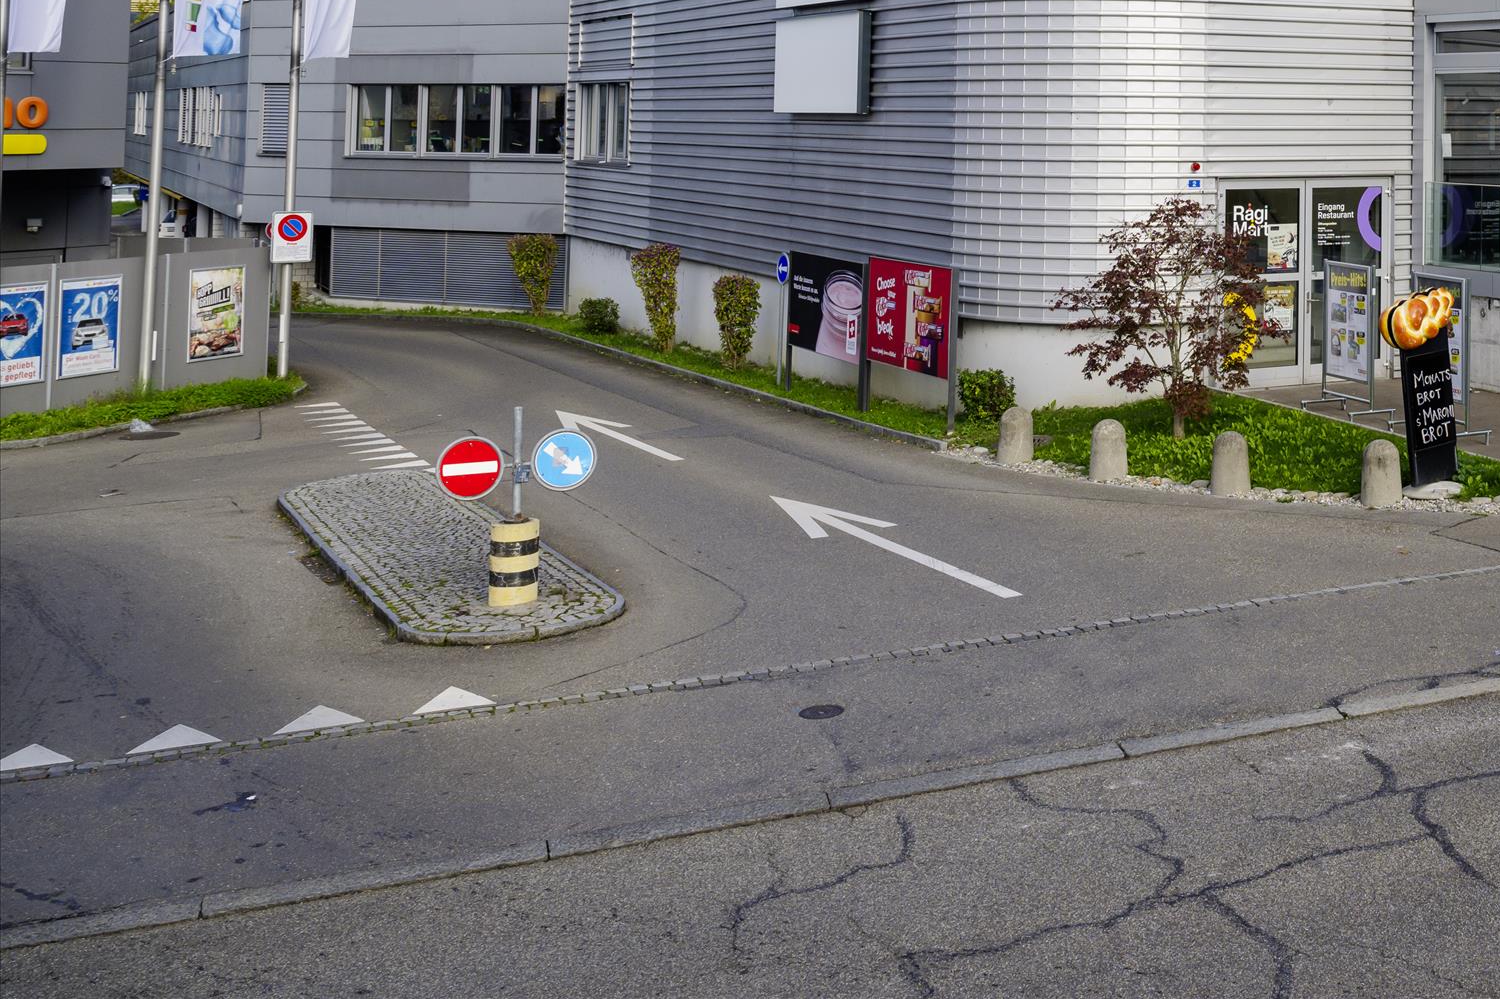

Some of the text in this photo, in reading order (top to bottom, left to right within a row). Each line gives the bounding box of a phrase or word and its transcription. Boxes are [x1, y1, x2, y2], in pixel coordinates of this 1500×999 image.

[1317, 202, 1345, 212] Eingang
[1317, 211, 1355, 219] Restaurant
[876, 276, 896, 291] Choose
[1330, 272, 1367, 288] Preis-Hits!
[4, 370, 37, 382] gepflegt
[1413, 368, 1451, 390] MONATS
[1416, 387, 1442, 406] BROT
[1421, 420, 1451, 445] BROT
